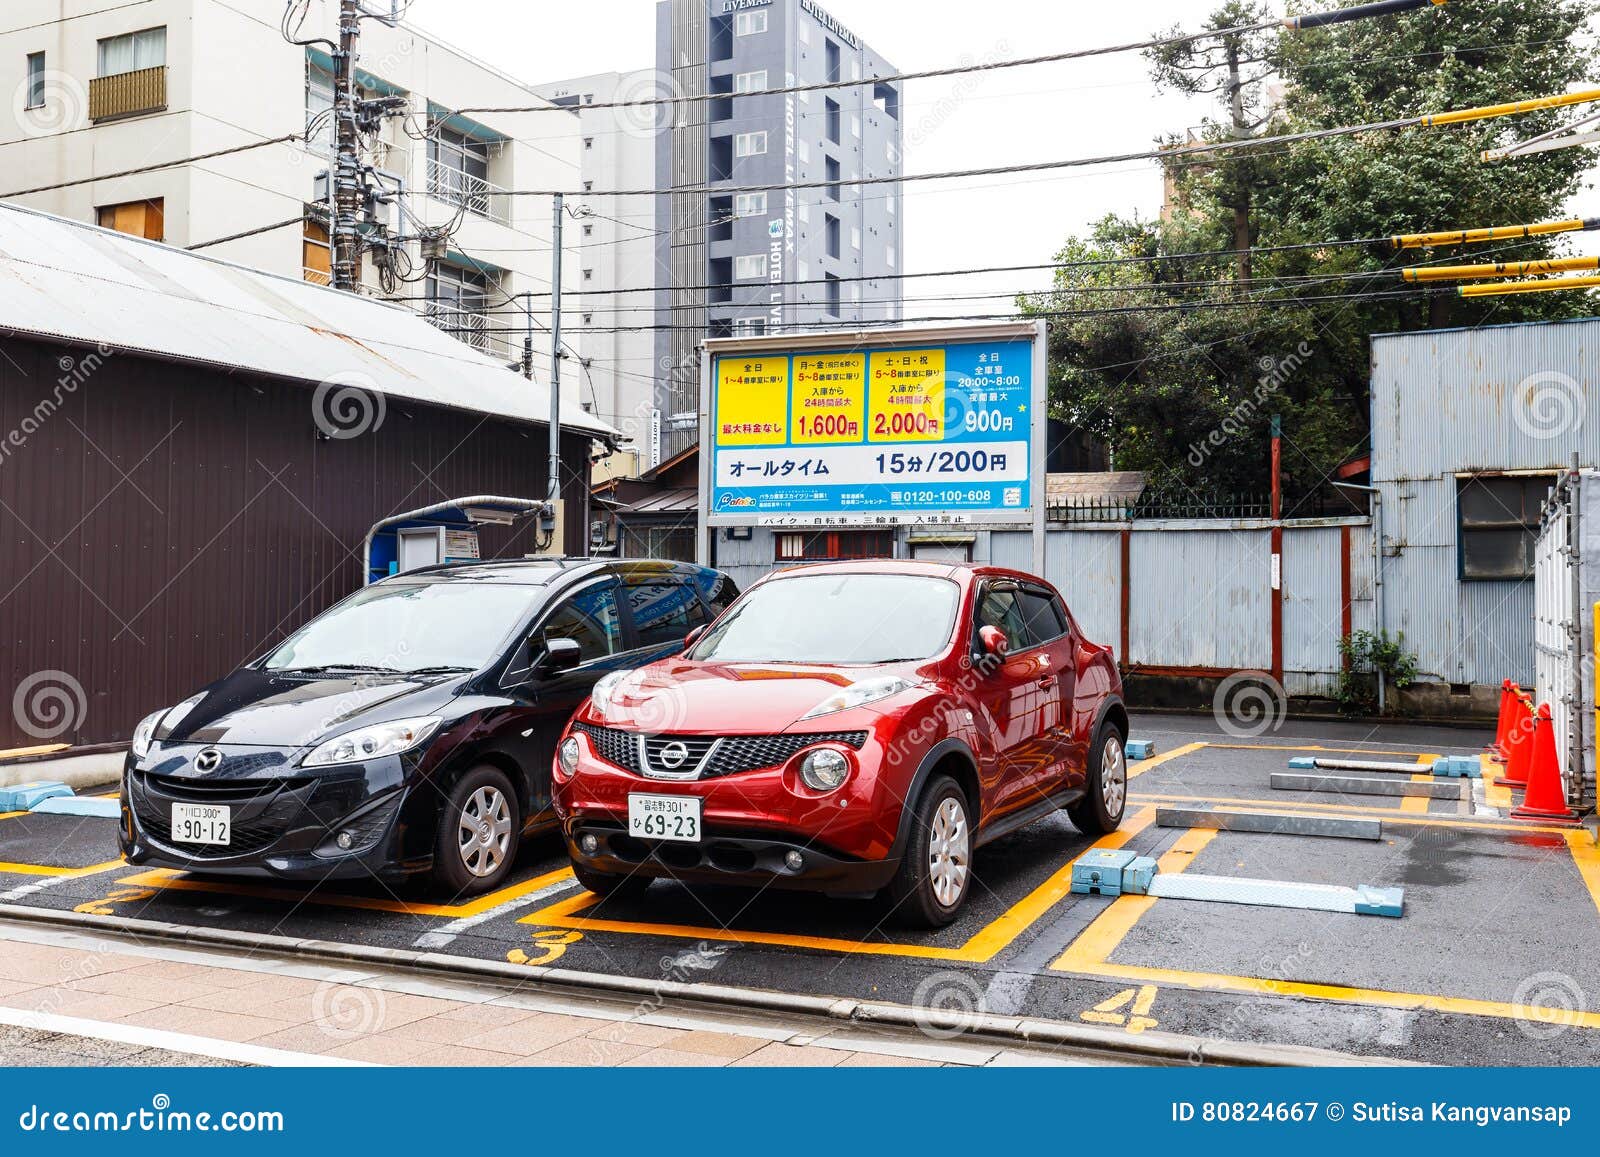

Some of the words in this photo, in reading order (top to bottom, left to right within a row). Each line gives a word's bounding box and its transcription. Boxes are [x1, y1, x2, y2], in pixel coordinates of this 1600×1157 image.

[785, 98, 795, 157] HOTEL
[978, 352, 999, 362] 全日
[744, 364, 762, 372] 全日
[811, 387, 844, 396] 入庫から
[889, 383, 924, 393] 入庫から
[804, 397, 852, 407] 24時間最大
[722, 423, 782, 434] 最大料金なし
[799, 414, 858, 438] 1,600円
[874, 412, 938, 436] 2,000円
[965, 409, 1013, 432] 900円
[730, 459, 830, 477] オールタイム
[903, 490, 991, 502] 0120-100-608
[184, 819, 227, 841] 90-12
[633, 817, 642, 829] ひ
[644, 814, 696, 837] 69-23
[506, 929, 584, 966] 3
[1080, 984, 1158, 1034] 4
